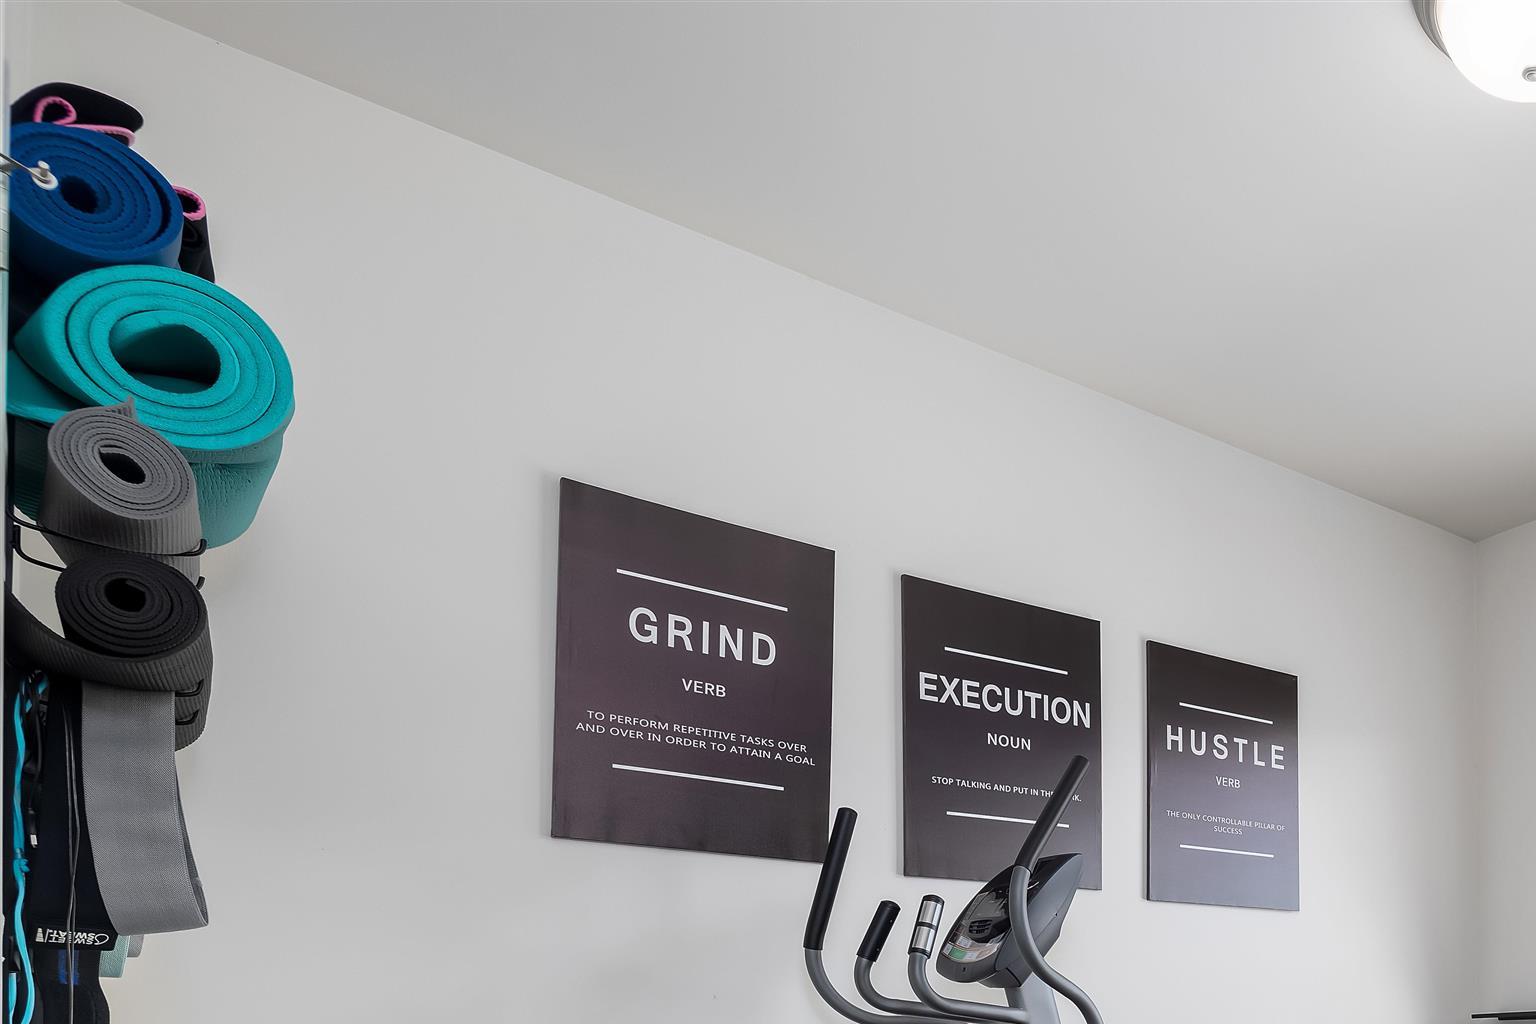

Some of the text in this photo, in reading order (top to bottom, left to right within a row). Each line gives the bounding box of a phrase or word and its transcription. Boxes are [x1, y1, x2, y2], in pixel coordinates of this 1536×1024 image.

[628, 606, 777, 667] GRIND
[681, 678, 727, 698] VERB
[919, 671, 1092, 729] EXECUTION
[587, 710, 807, 753] TO PERFORM REPETITIVE TASKS OVER
[987, 732, 1032, 751] NOUN
[576, 722, 816, 766] AND OVER IN ORDER TO ATTAIN A GOAL
[1166, 724, 1285, 770] HUSTLE
[931, 775, 954, 786] STOP
[955, 778, 992, 791] TALKING
[993, 783, 1011, 793] AND
[1012, 786, 1029, 795] PUT
[1030, 788, 1039, 796] IN
[1215, 775, 1241, 789] VERB
[1166, 809, 1286, 832] THE ONLY CONTROLLABLE PILLAR OF
[1213, 825, 1243, 835] SUCCESS
